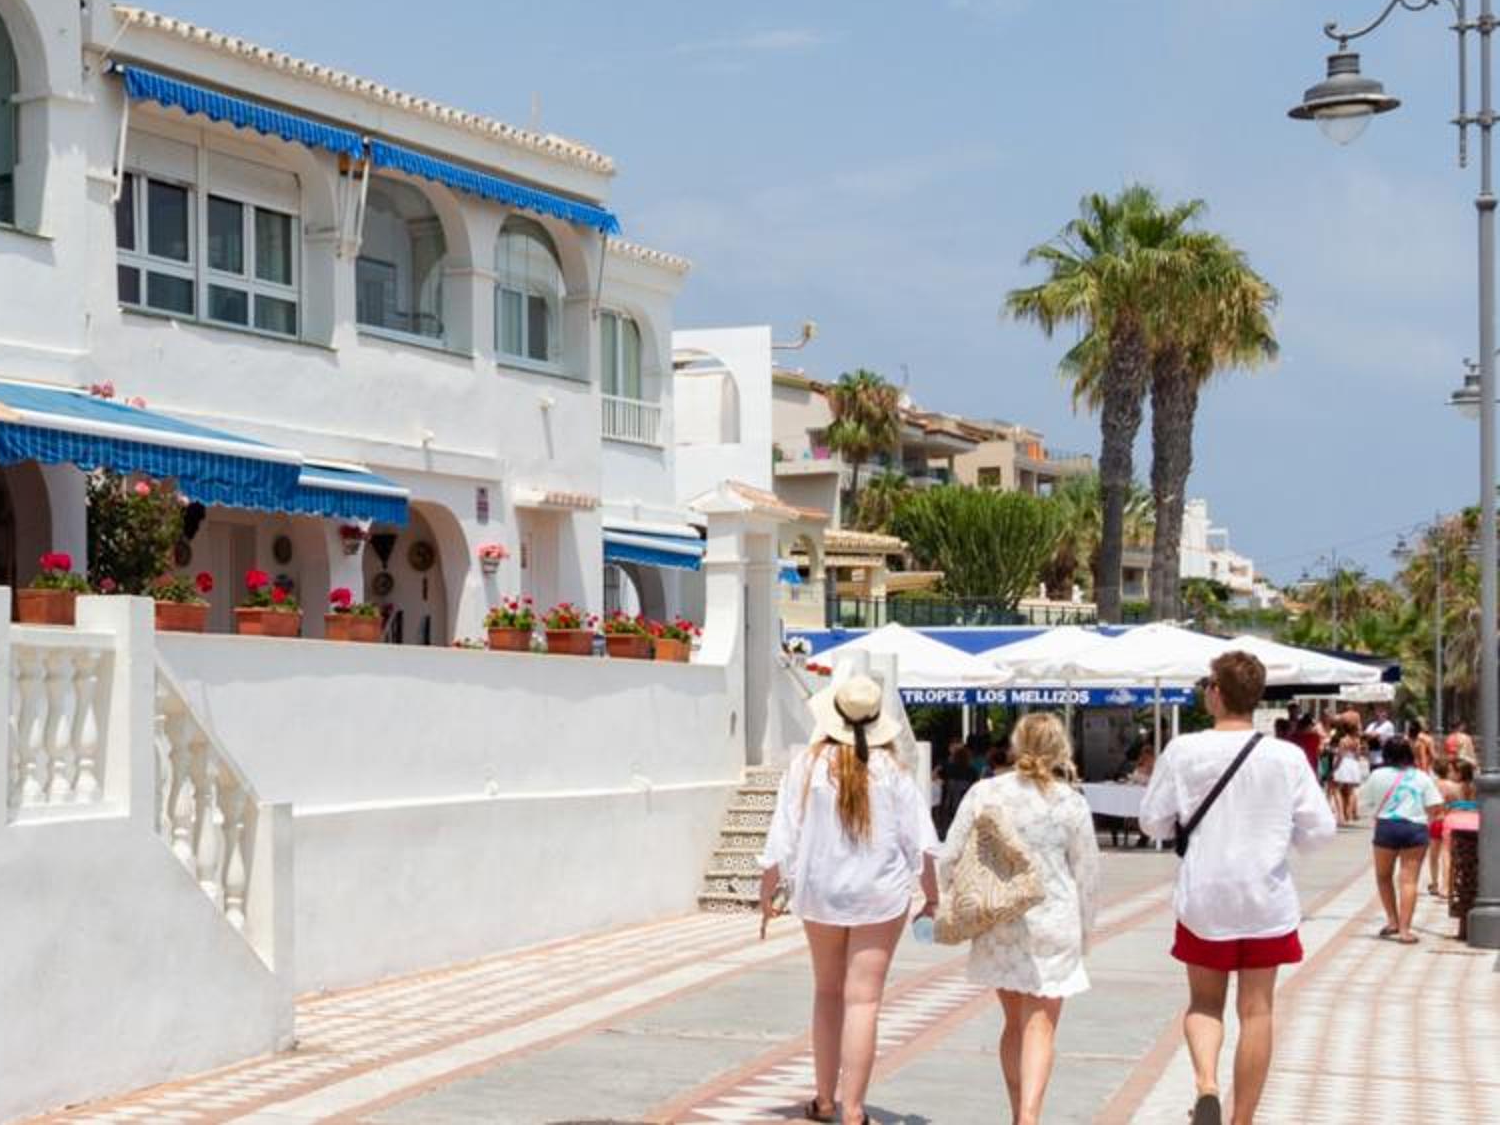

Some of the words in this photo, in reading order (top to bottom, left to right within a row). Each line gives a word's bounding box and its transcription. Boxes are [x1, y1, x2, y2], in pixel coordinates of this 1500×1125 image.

[902, 689, 966, 704] TROPEZ
[975, 689, 1006, 704] LOS
[1011, 689, 1090, 704] MELLIZOS
